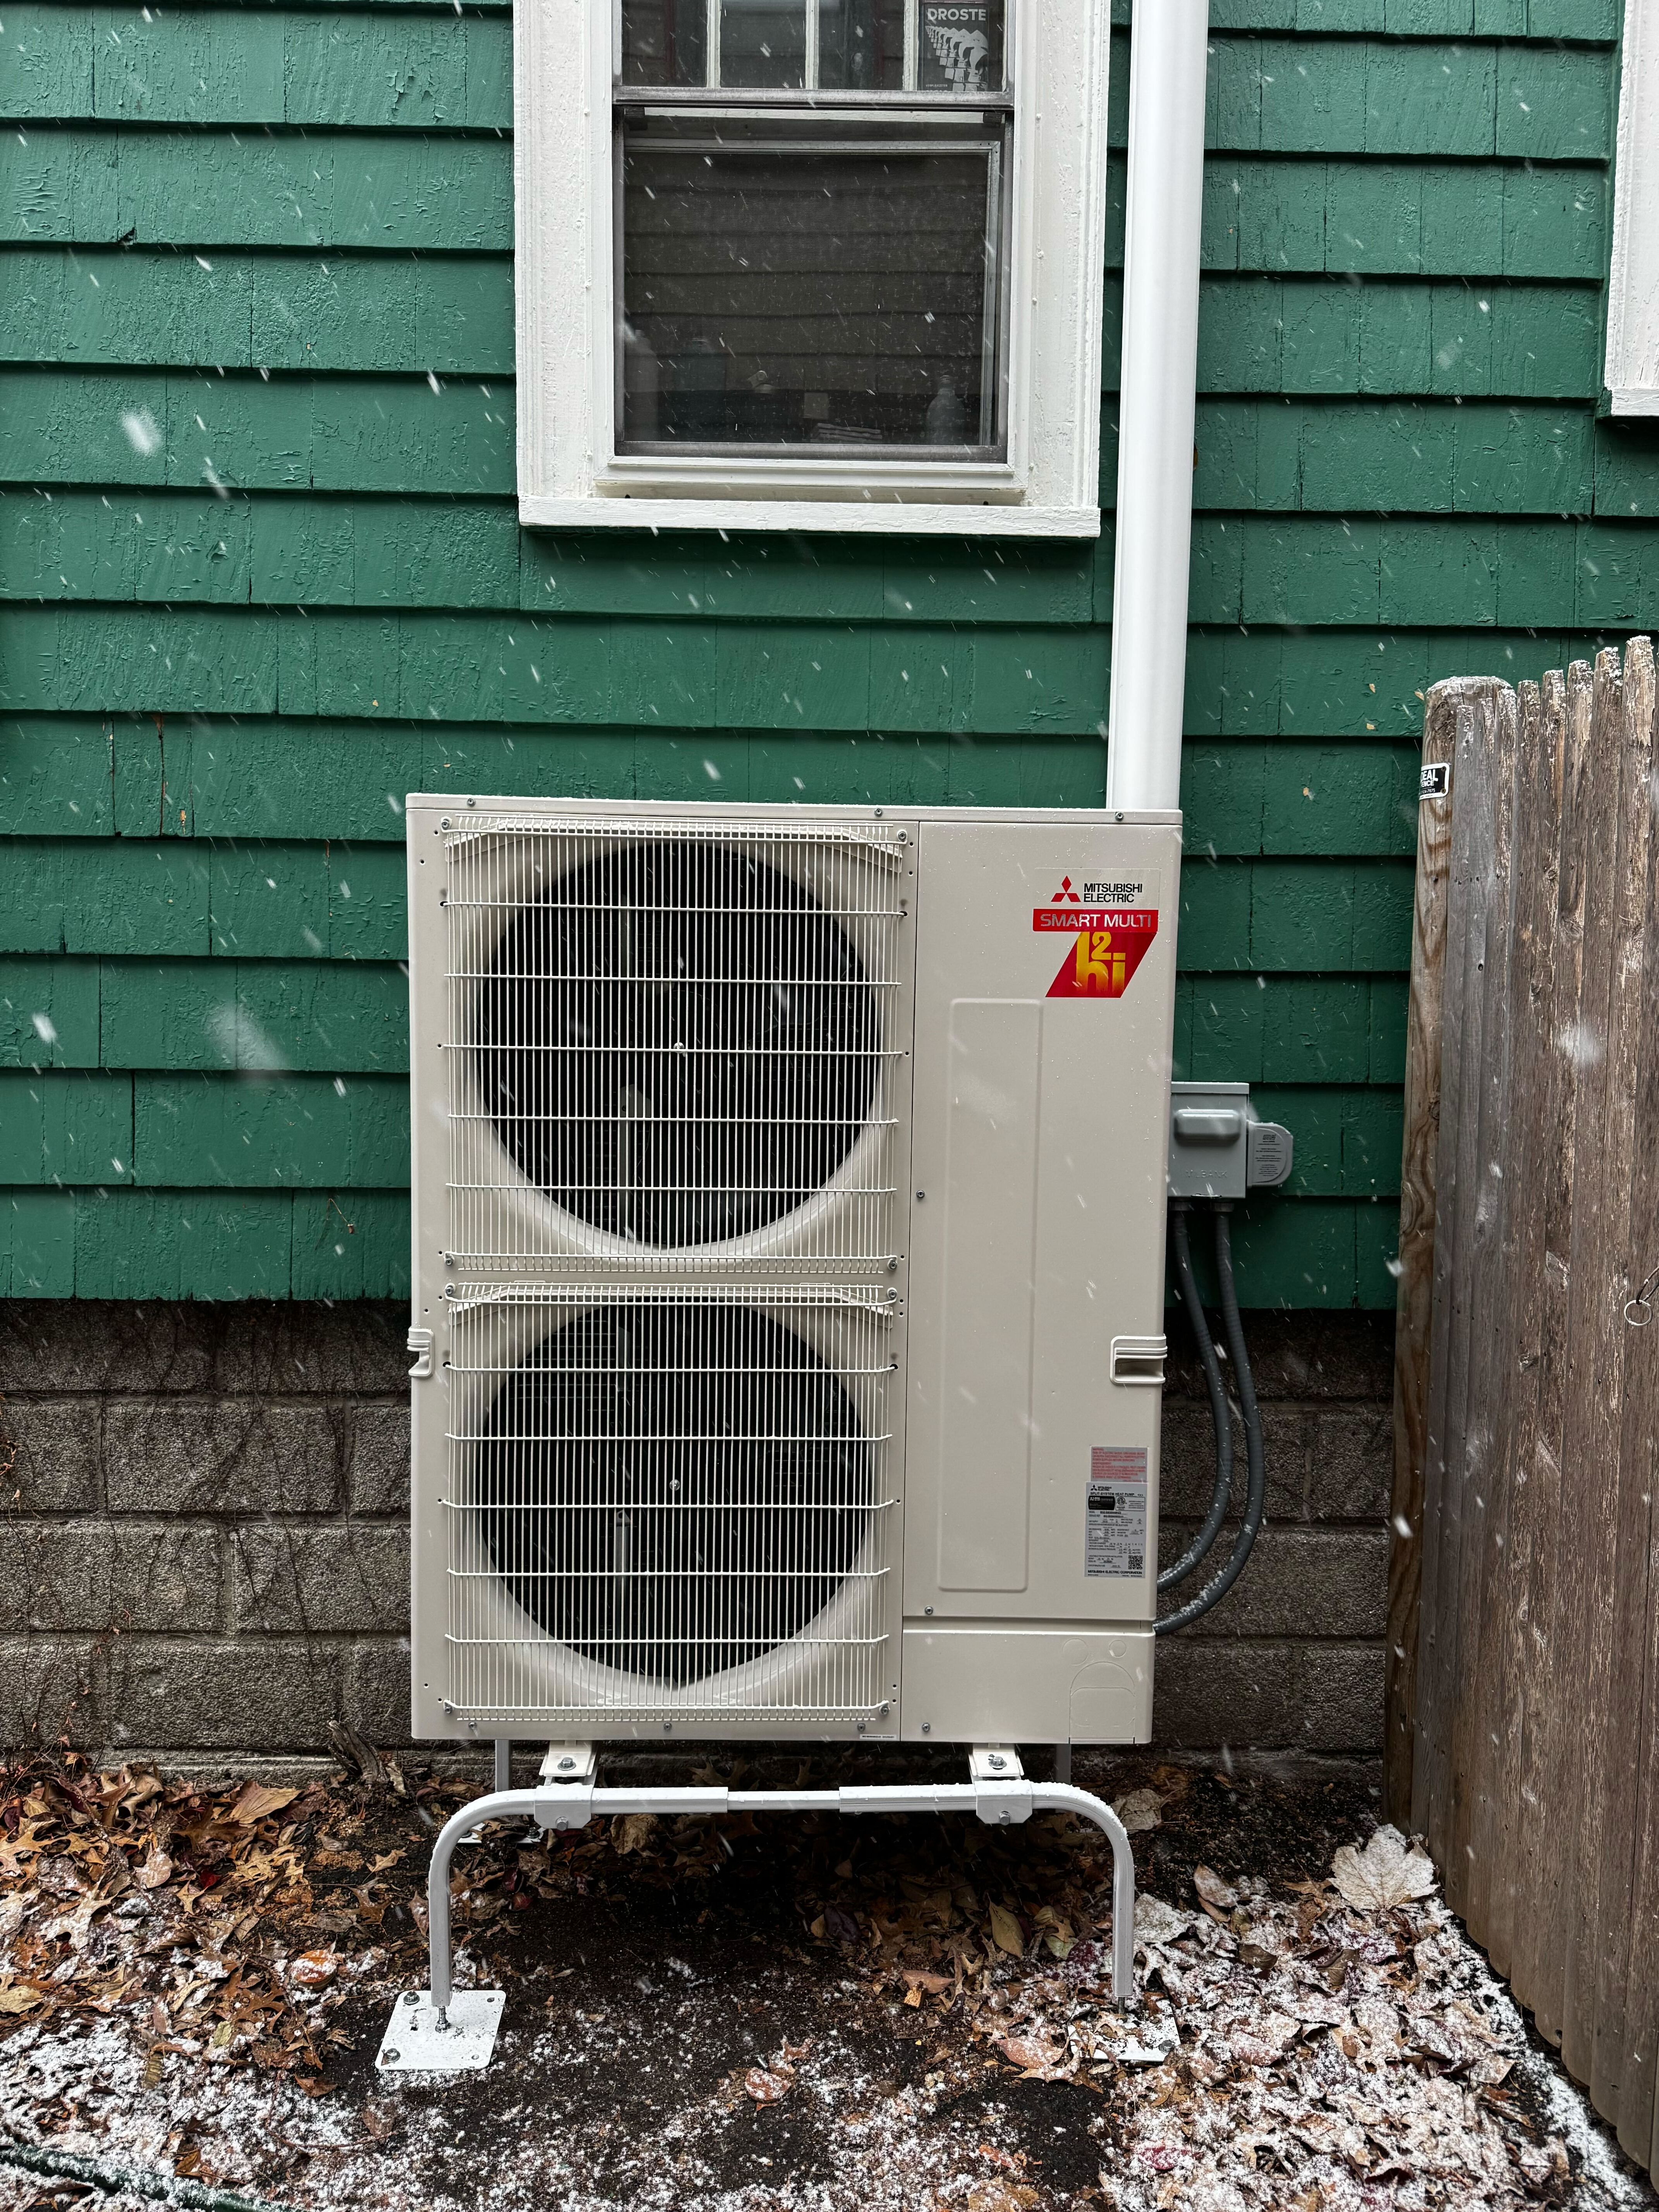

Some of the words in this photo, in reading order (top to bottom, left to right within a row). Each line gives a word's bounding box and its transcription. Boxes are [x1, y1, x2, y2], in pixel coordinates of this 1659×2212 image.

[928, 9, 986, 21] DROSTE
[1084, 883, 1142, 893] MITSUBISHI
[1084, 893, 1134, 903] ELECTRIC
[1040, 914, 1101, 927] SMART
[1104, 914, 1151, 927] MULTI
[1185, 1169, 1228, 1178] MLBANK
